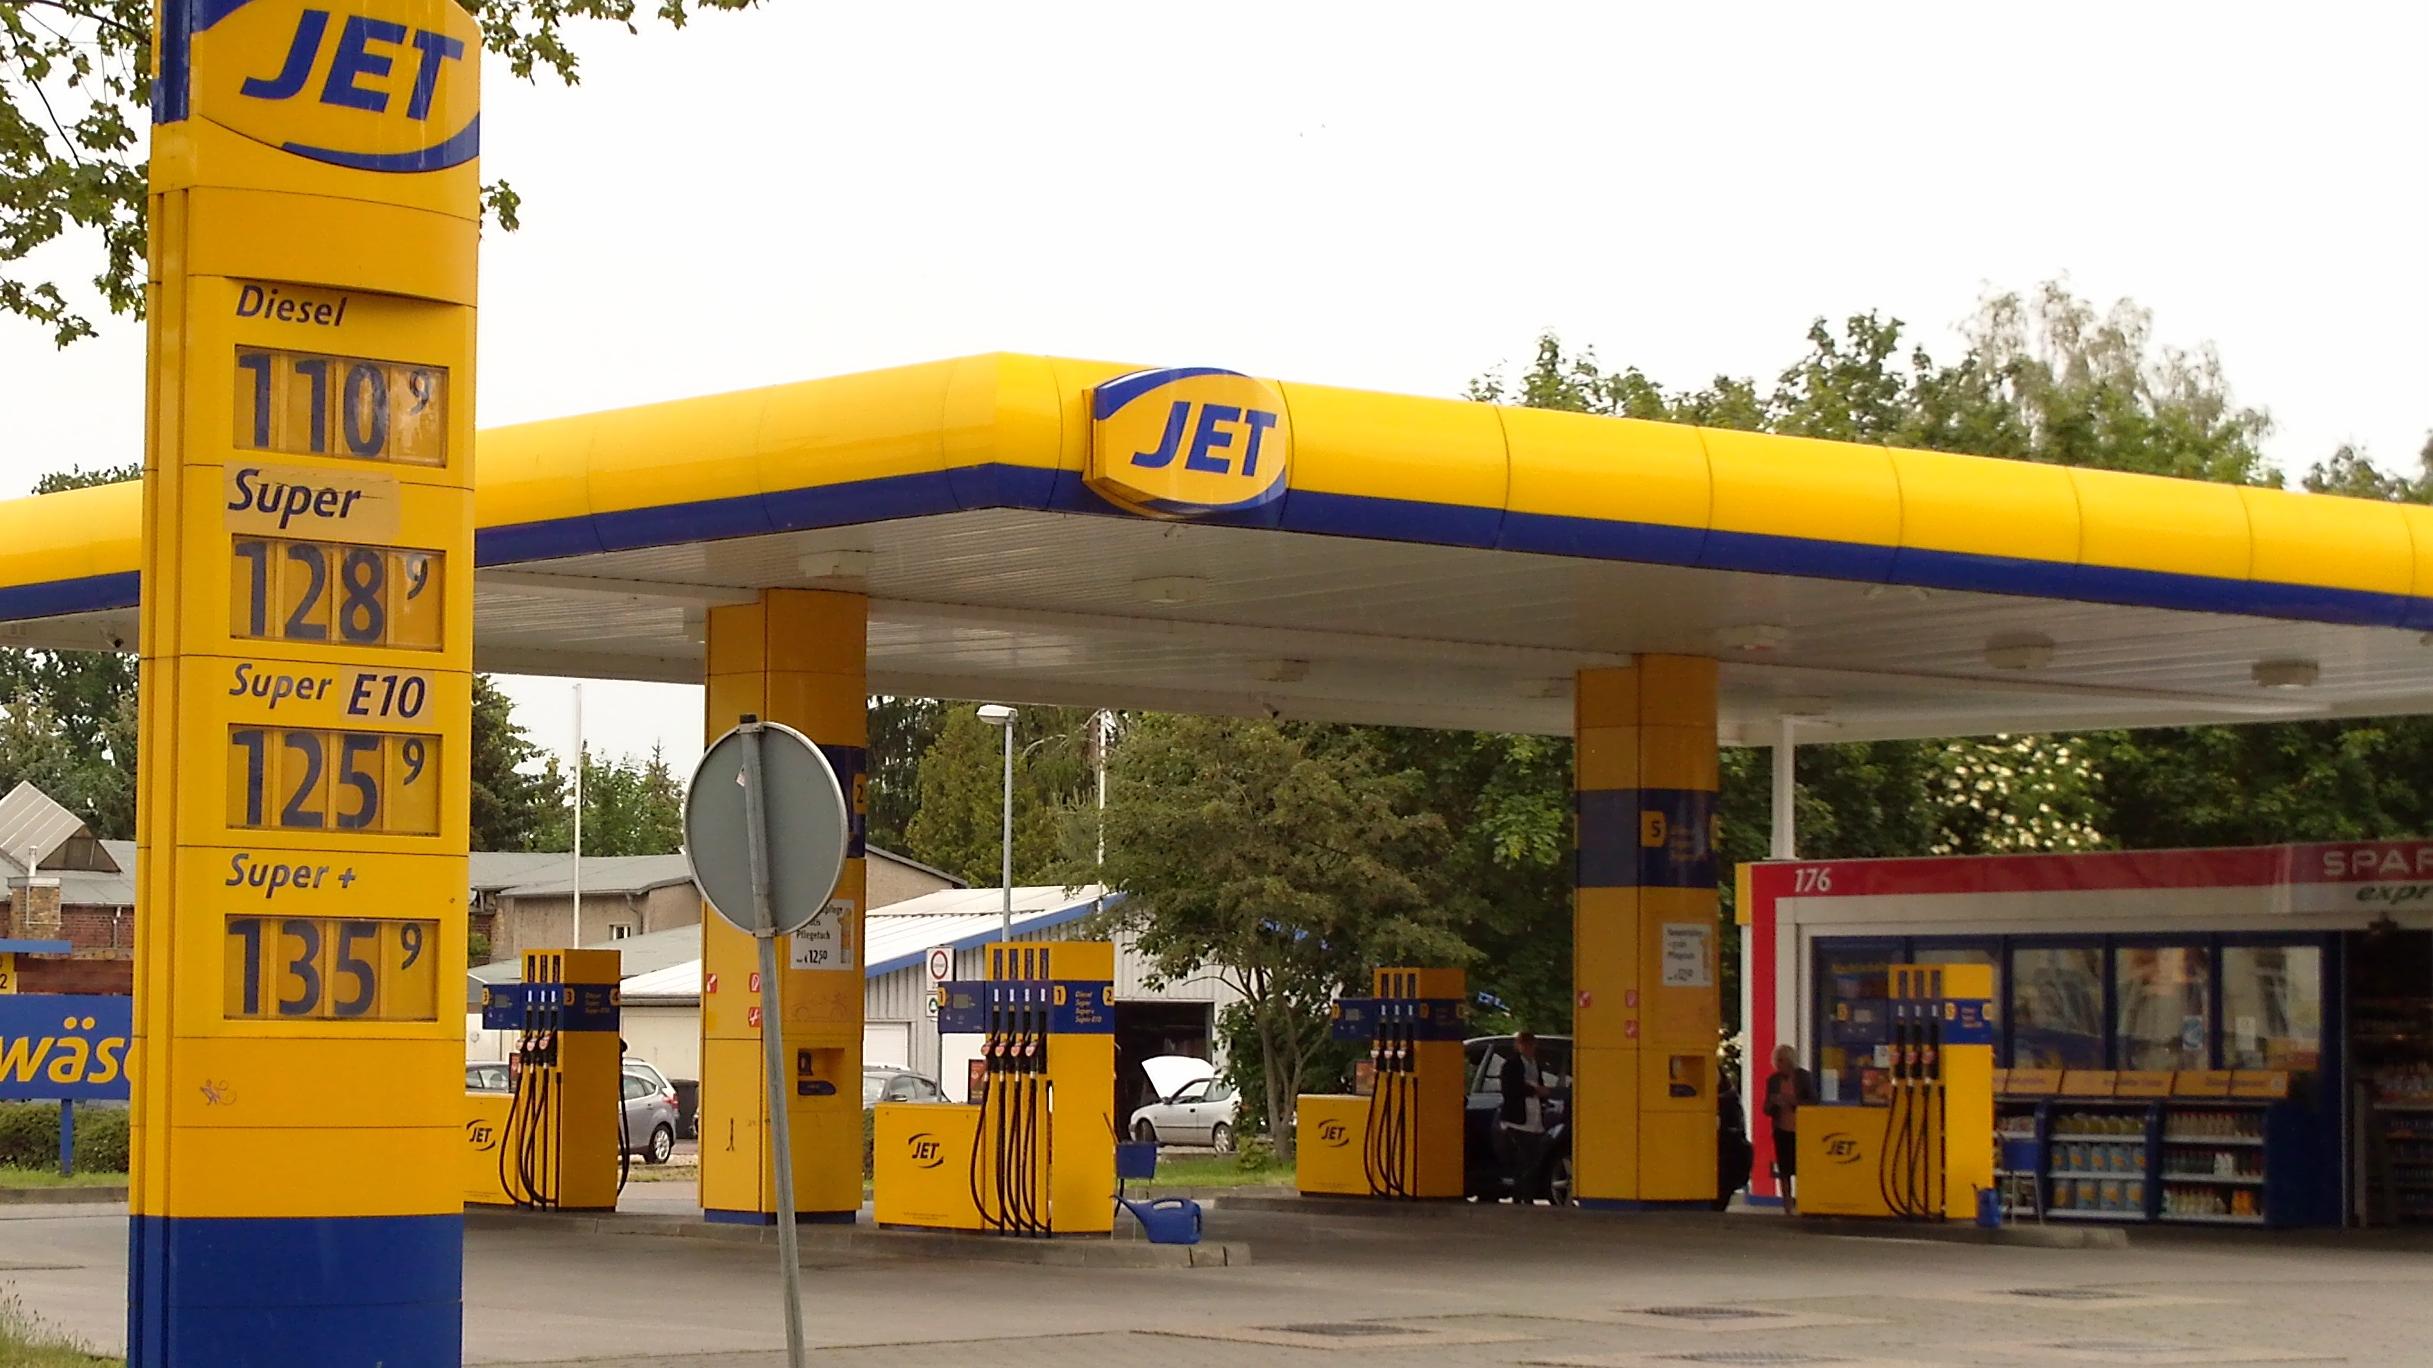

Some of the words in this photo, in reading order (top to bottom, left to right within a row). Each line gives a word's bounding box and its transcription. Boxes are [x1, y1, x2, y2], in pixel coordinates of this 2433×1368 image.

[240, 8, 465, 122] JET
[236, 284, 348, 327] Diesel
[1131, 401, 1277, 477] JET
[228, 467, 362, 530] Super
[228, 662, 333, 710] Super
[346, 673, 427, 719] E10
[1651, 820, 1661, 838] 5
[225, 852, 330, 899] Super
[338, 867, 357, 889] +
[1794, 867, 1832, 893] 176
[1106, 989, 1112, 1002] 2
[0, 1016, 133, 1083] wäs
[469, 1127, 493, 1144] JET
[1320, 1126, 1346, 1141] JET
[1827, 1140, 1857, 1156] JET
[912, 1142, 940, 1160] JET
